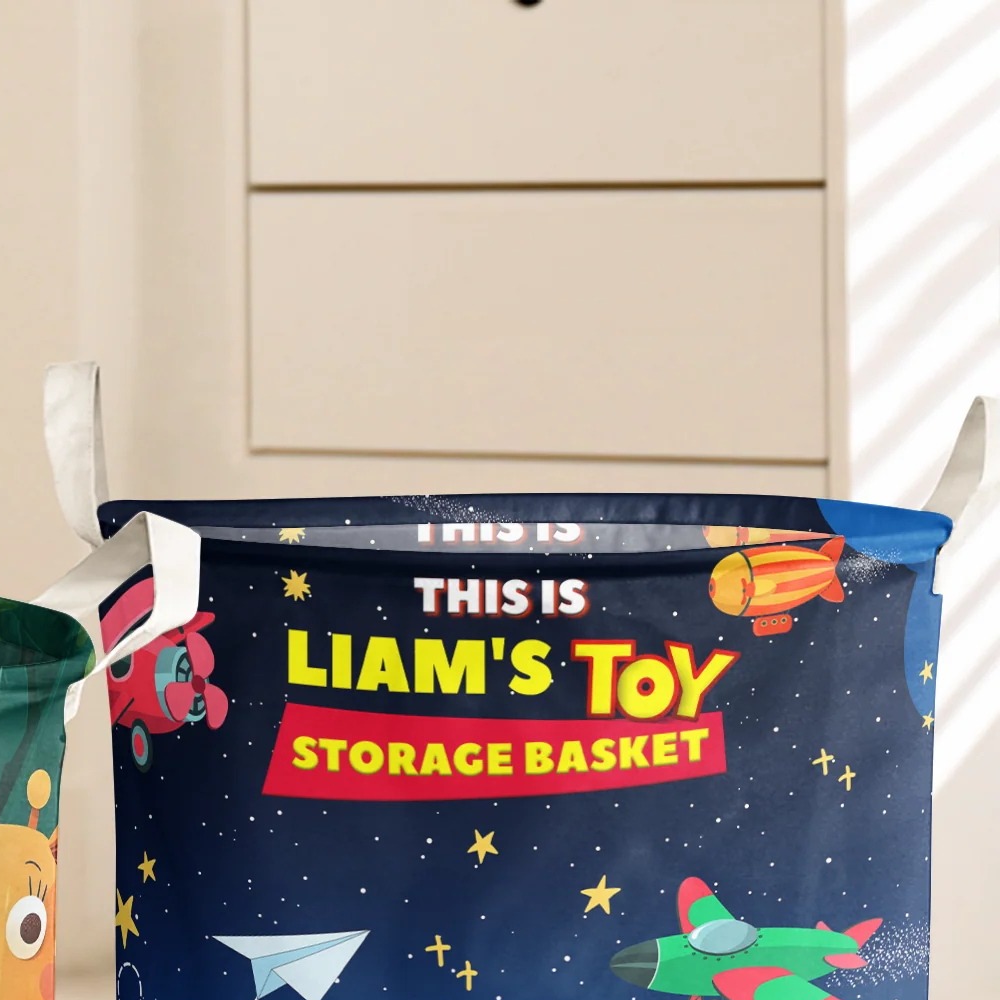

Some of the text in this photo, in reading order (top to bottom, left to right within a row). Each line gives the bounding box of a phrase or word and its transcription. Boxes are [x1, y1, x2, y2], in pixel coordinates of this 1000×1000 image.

[414, 577, 588, 616] THIS IS
[288, 629, 553, 696] LIAM'S
[292, 727, 709, 776] STORAGE BASKET
